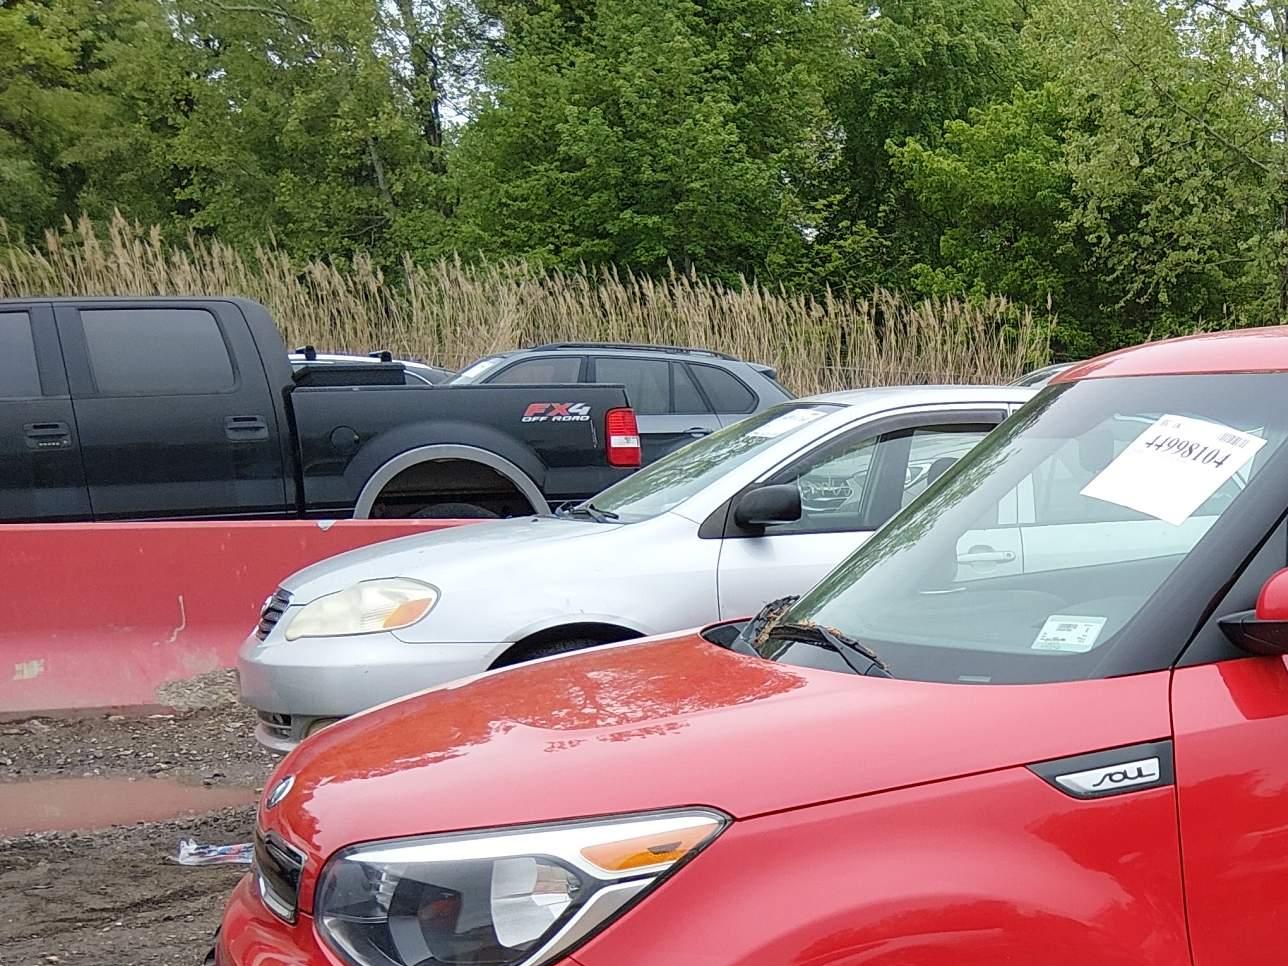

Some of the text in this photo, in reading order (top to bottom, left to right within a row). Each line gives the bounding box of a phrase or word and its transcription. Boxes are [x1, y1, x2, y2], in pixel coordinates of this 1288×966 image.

[524, 403, 591, 417] FX4
[1145, 434, 1232, 469] 44998104
[1092, 767, 1156, 787] SOUL
